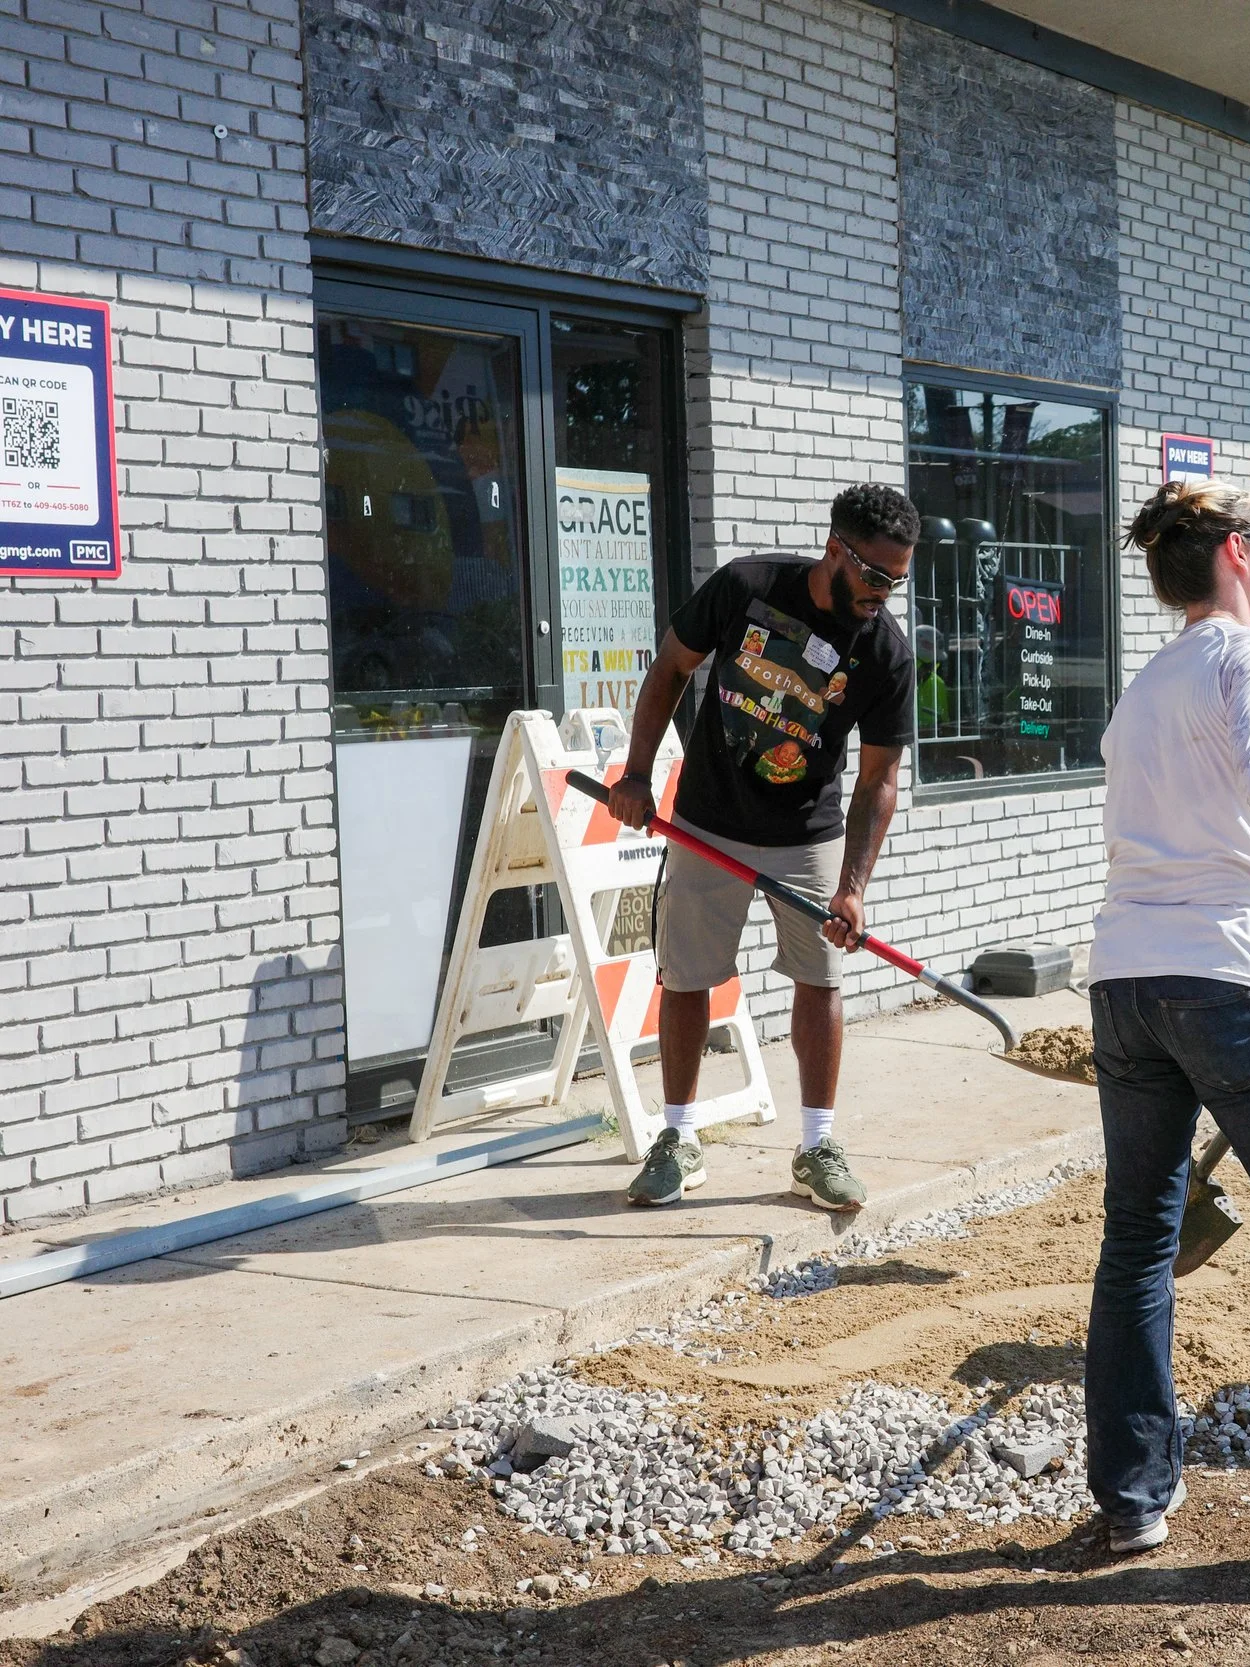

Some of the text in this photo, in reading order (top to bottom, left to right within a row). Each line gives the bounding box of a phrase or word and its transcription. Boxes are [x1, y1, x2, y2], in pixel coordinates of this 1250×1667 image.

[22, 317, 93, 349] HERE
[0, 375, 67, 390] CAN QR CODE
[1168, 447, 1209, 466] PAY HERE
[27, 481, 41, 490] OR
[34, 501, 89, 511] 409-405-5080
[0, 545, 105, 560] gmgt.com PMC
[560, 539, 648, 561] ISN'T A LITTLE
[561, 566, 651, 593] PRAYER
[562, 599, 652, 619] YOU SAY BEFORE
[1008, 588, 1061, 624] OPEN
[561, 627, 652, 642] RECEIVING A MEAL
[1025, 626, 1051, 641] Dine-In
[563, 649, 652, 673] IT'S A WAY TO
[1020, 649, 1053, 666] Curbside
[740, 656, 816, 707] Brothers
[1022, 673, 1051, 691] Pick-Up
[580, 679, 638, 710] LIVE
[1020, 696, 1052, 713] Take-Out
[1020, 720, 1049, 740] Delivery
